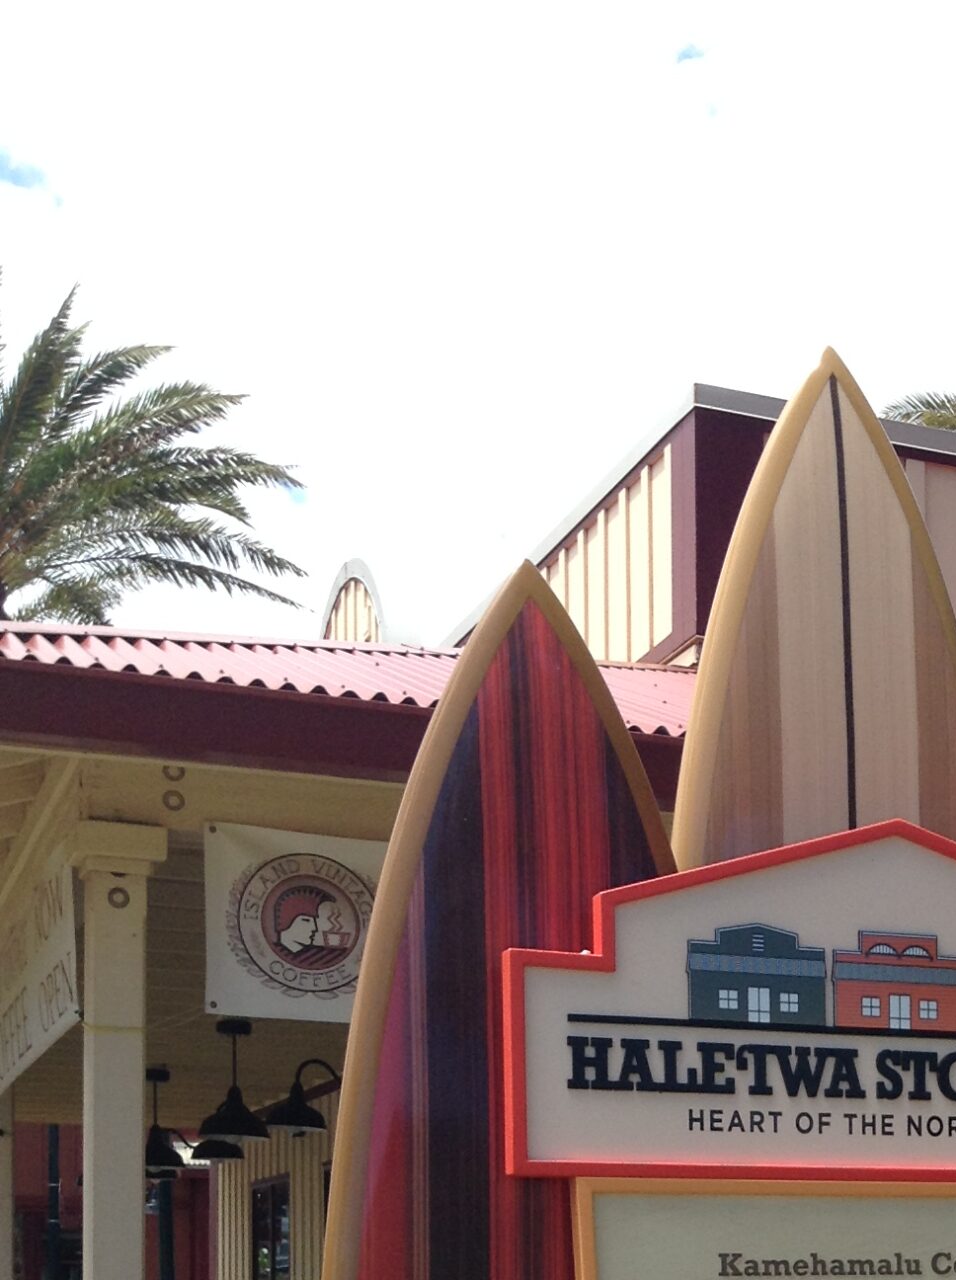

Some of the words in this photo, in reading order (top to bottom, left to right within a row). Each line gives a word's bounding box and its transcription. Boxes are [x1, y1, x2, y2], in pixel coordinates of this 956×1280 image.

[243, 858, 301, 920] ISLAND
[268, 959, 352, 988] COFFEE
[688, 1108, 783, 1134] HEART
[795, 1111, 832, 1135] OF
[843, 1112, 895, 1136] THE
[717, 1252, 923, 1278] Kamehamalu
